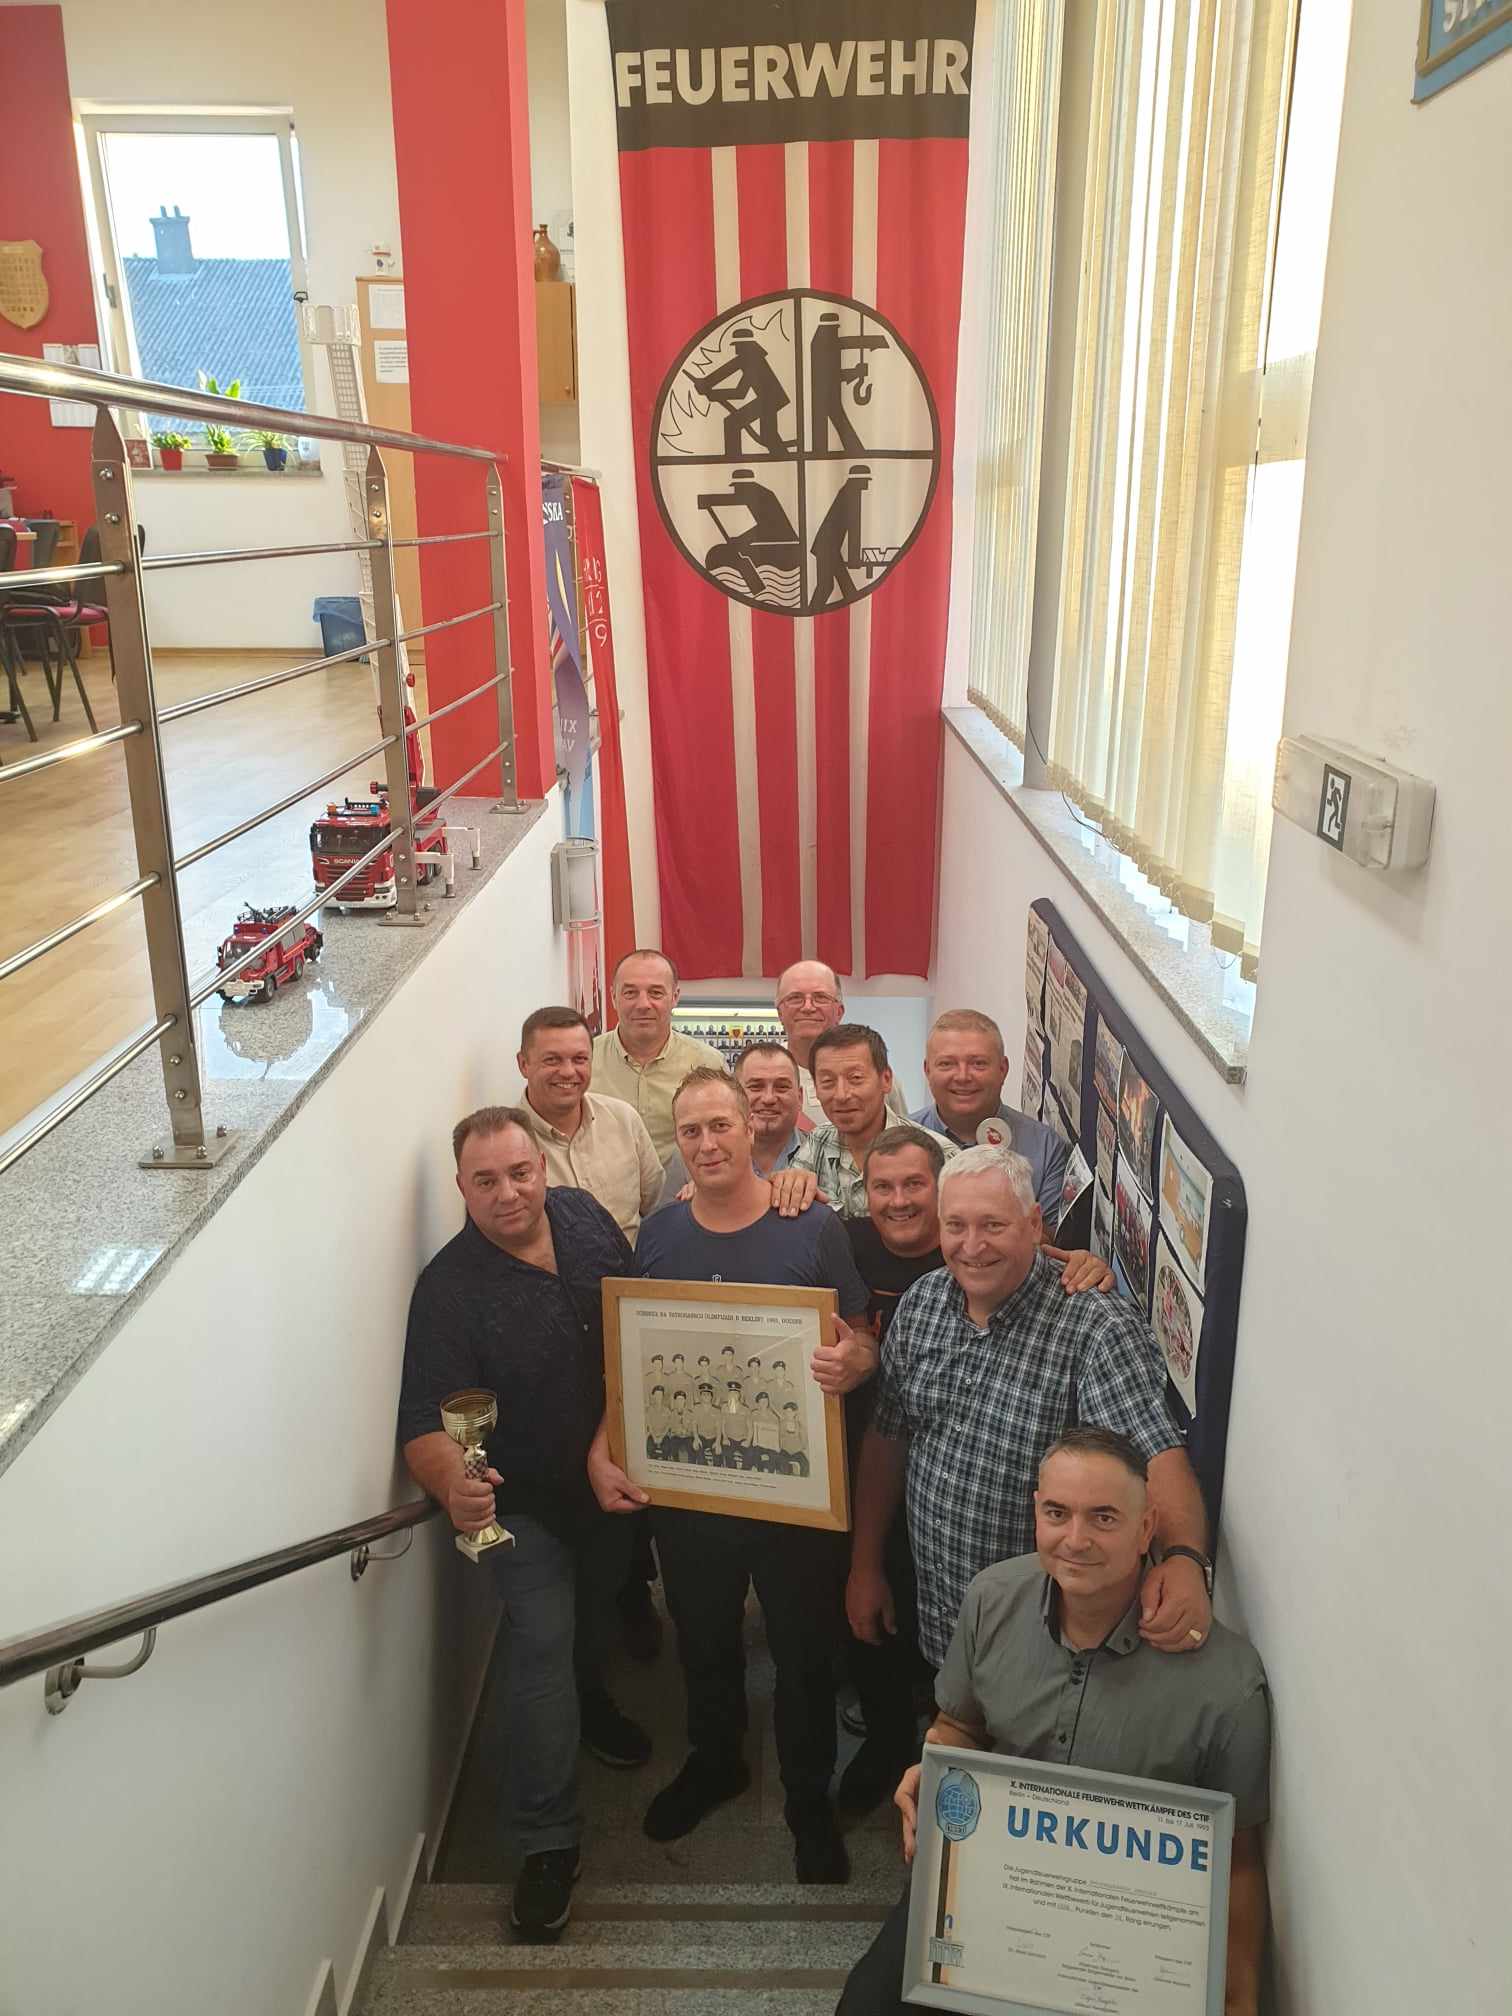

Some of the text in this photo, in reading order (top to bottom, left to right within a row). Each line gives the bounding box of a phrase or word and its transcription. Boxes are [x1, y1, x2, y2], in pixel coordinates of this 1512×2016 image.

[615, 38, 970, 108] FEUERWEHR
[1018, 1782, 1081, 1800] INTERNATIONALE
[1177, 1809, 1192, 1820] DES
[1193, 1812, 1210, 1823] CTIF
[1007, 1805, 1209, 1872] URKUNDE
